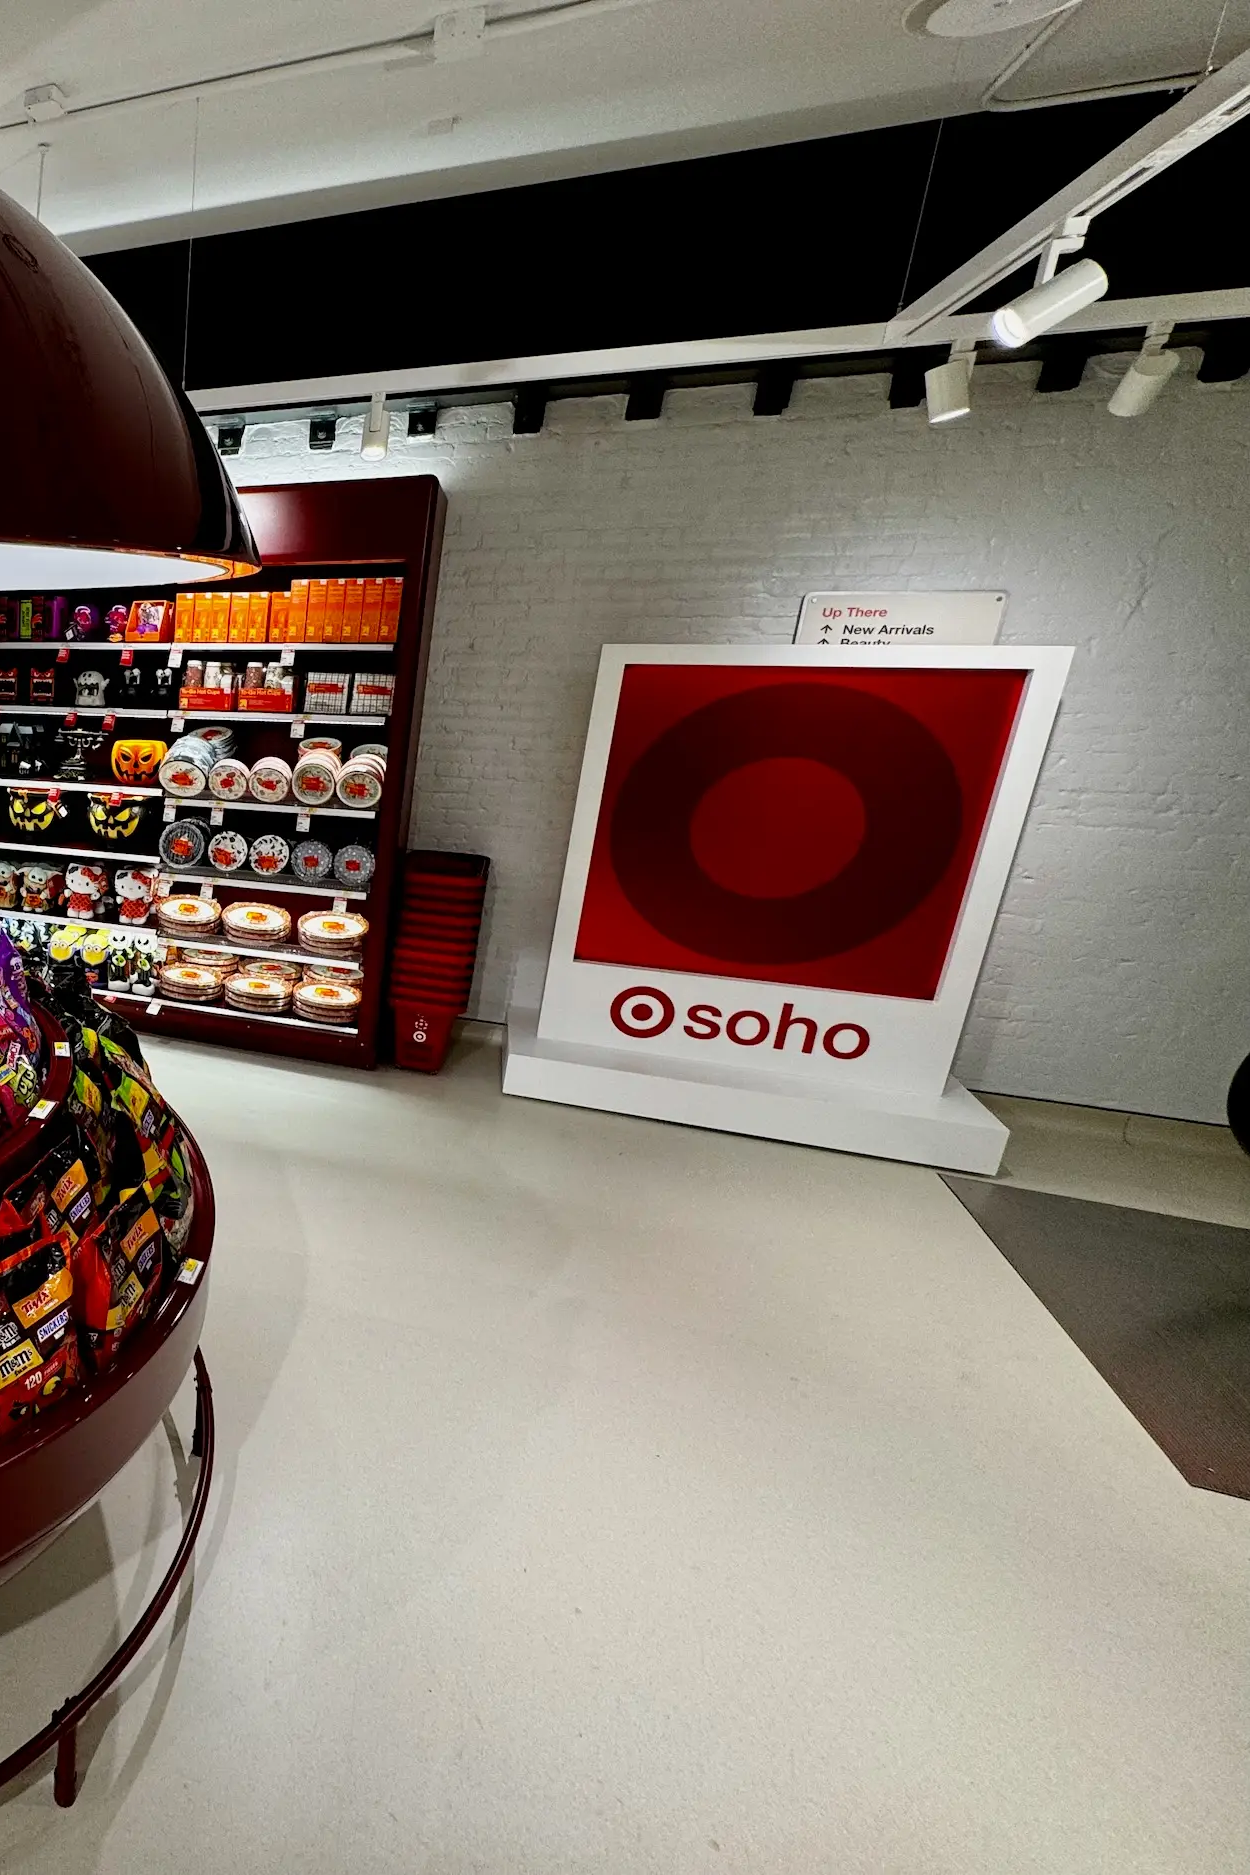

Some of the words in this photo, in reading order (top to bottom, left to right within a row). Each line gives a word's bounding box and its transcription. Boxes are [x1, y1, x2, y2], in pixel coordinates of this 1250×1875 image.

[822, 607, 841, 619] Up
[847, 607, 888, 618] There
[842, 624, 875, 635] New
[878, 624, 935, 635] Arrivals
[683, 1002, 871, 1061] soho
[56, 1177, 74, 1202] Twix
[70, 1193, 91, 1222] SNICKERS
[38, 1310, 70, 1341] SNICKERS
[24, 1371, 43, 1391] 120
